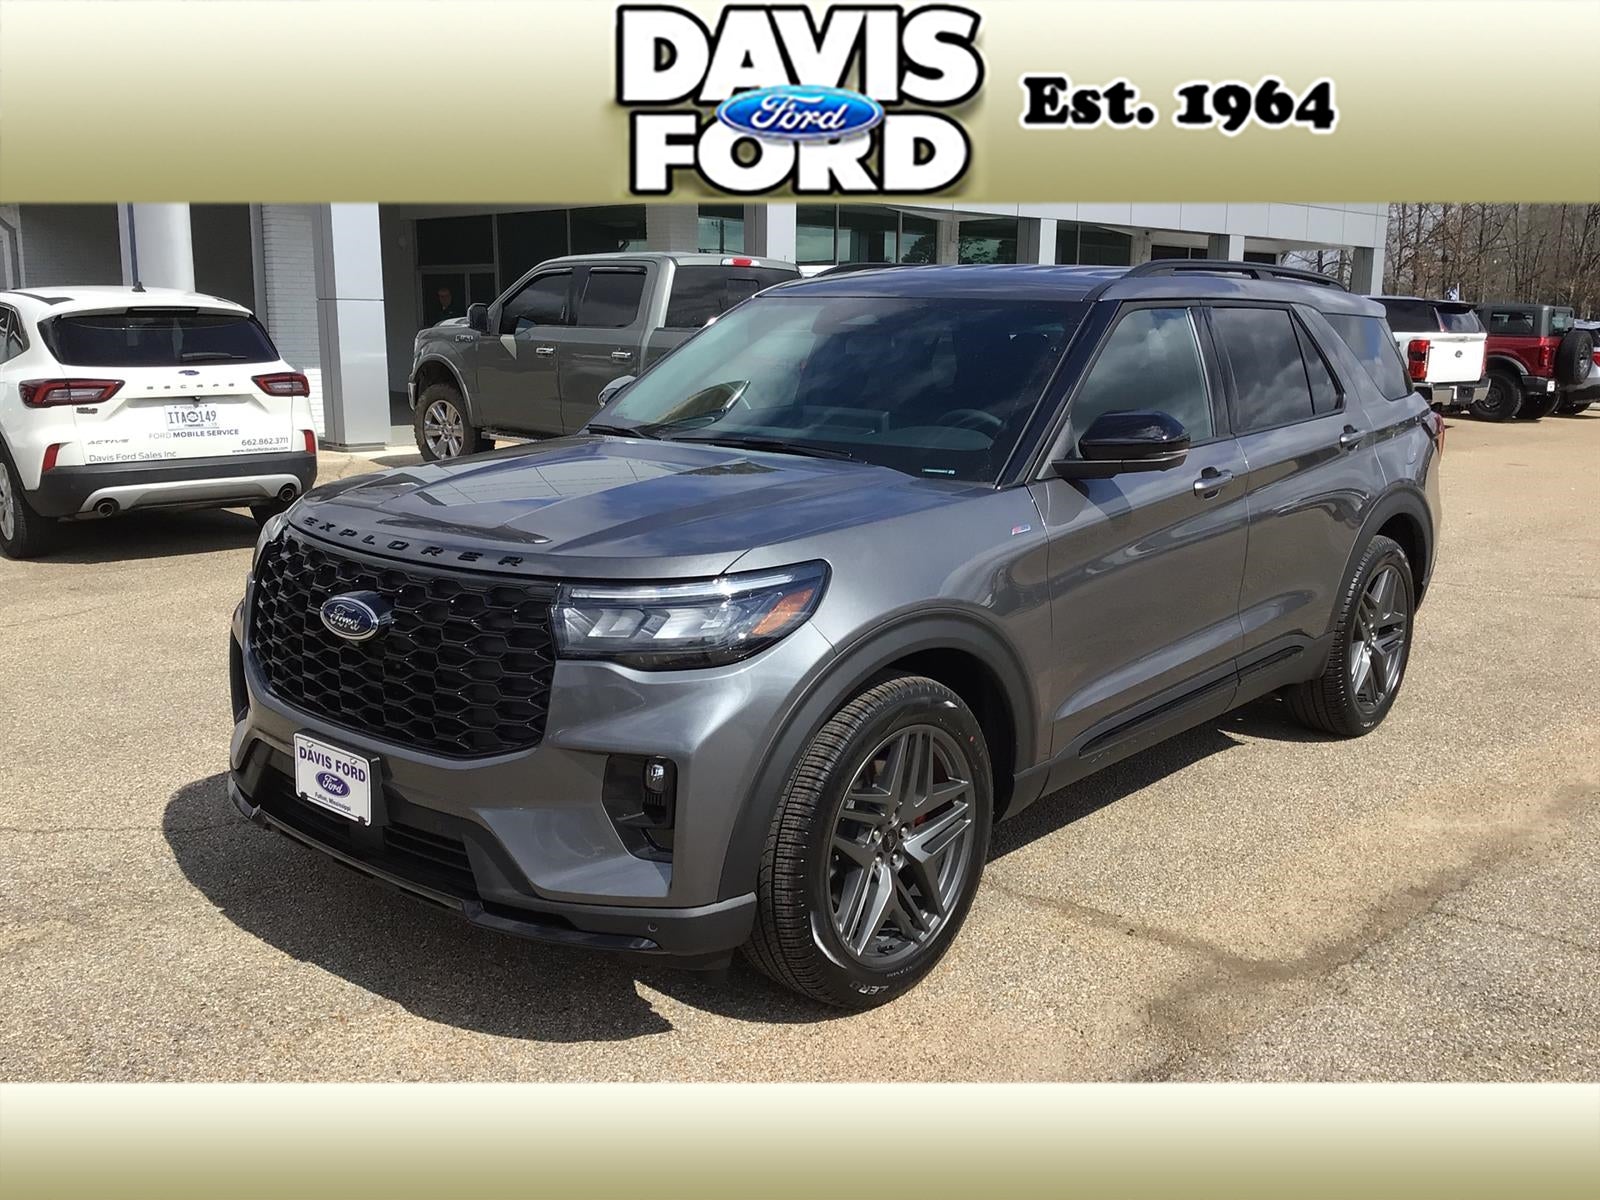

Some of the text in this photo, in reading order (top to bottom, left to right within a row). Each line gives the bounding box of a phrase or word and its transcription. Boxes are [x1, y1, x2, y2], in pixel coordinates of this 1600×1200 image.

[173, 430, 205, 438] MOBILE
[206, 428, 239, 437] SERVICE
[241, 437, 288, 446] 662.862.3711
[89, 450, 177, 462] Davis Ford Sales Inc
[303, 515, 524, 567] EXPLORER
[330, 604, 362, 631] Ford
[299, 747, 366, 783] DAVIS FORD
[322, 774, 343, 794] Ford
